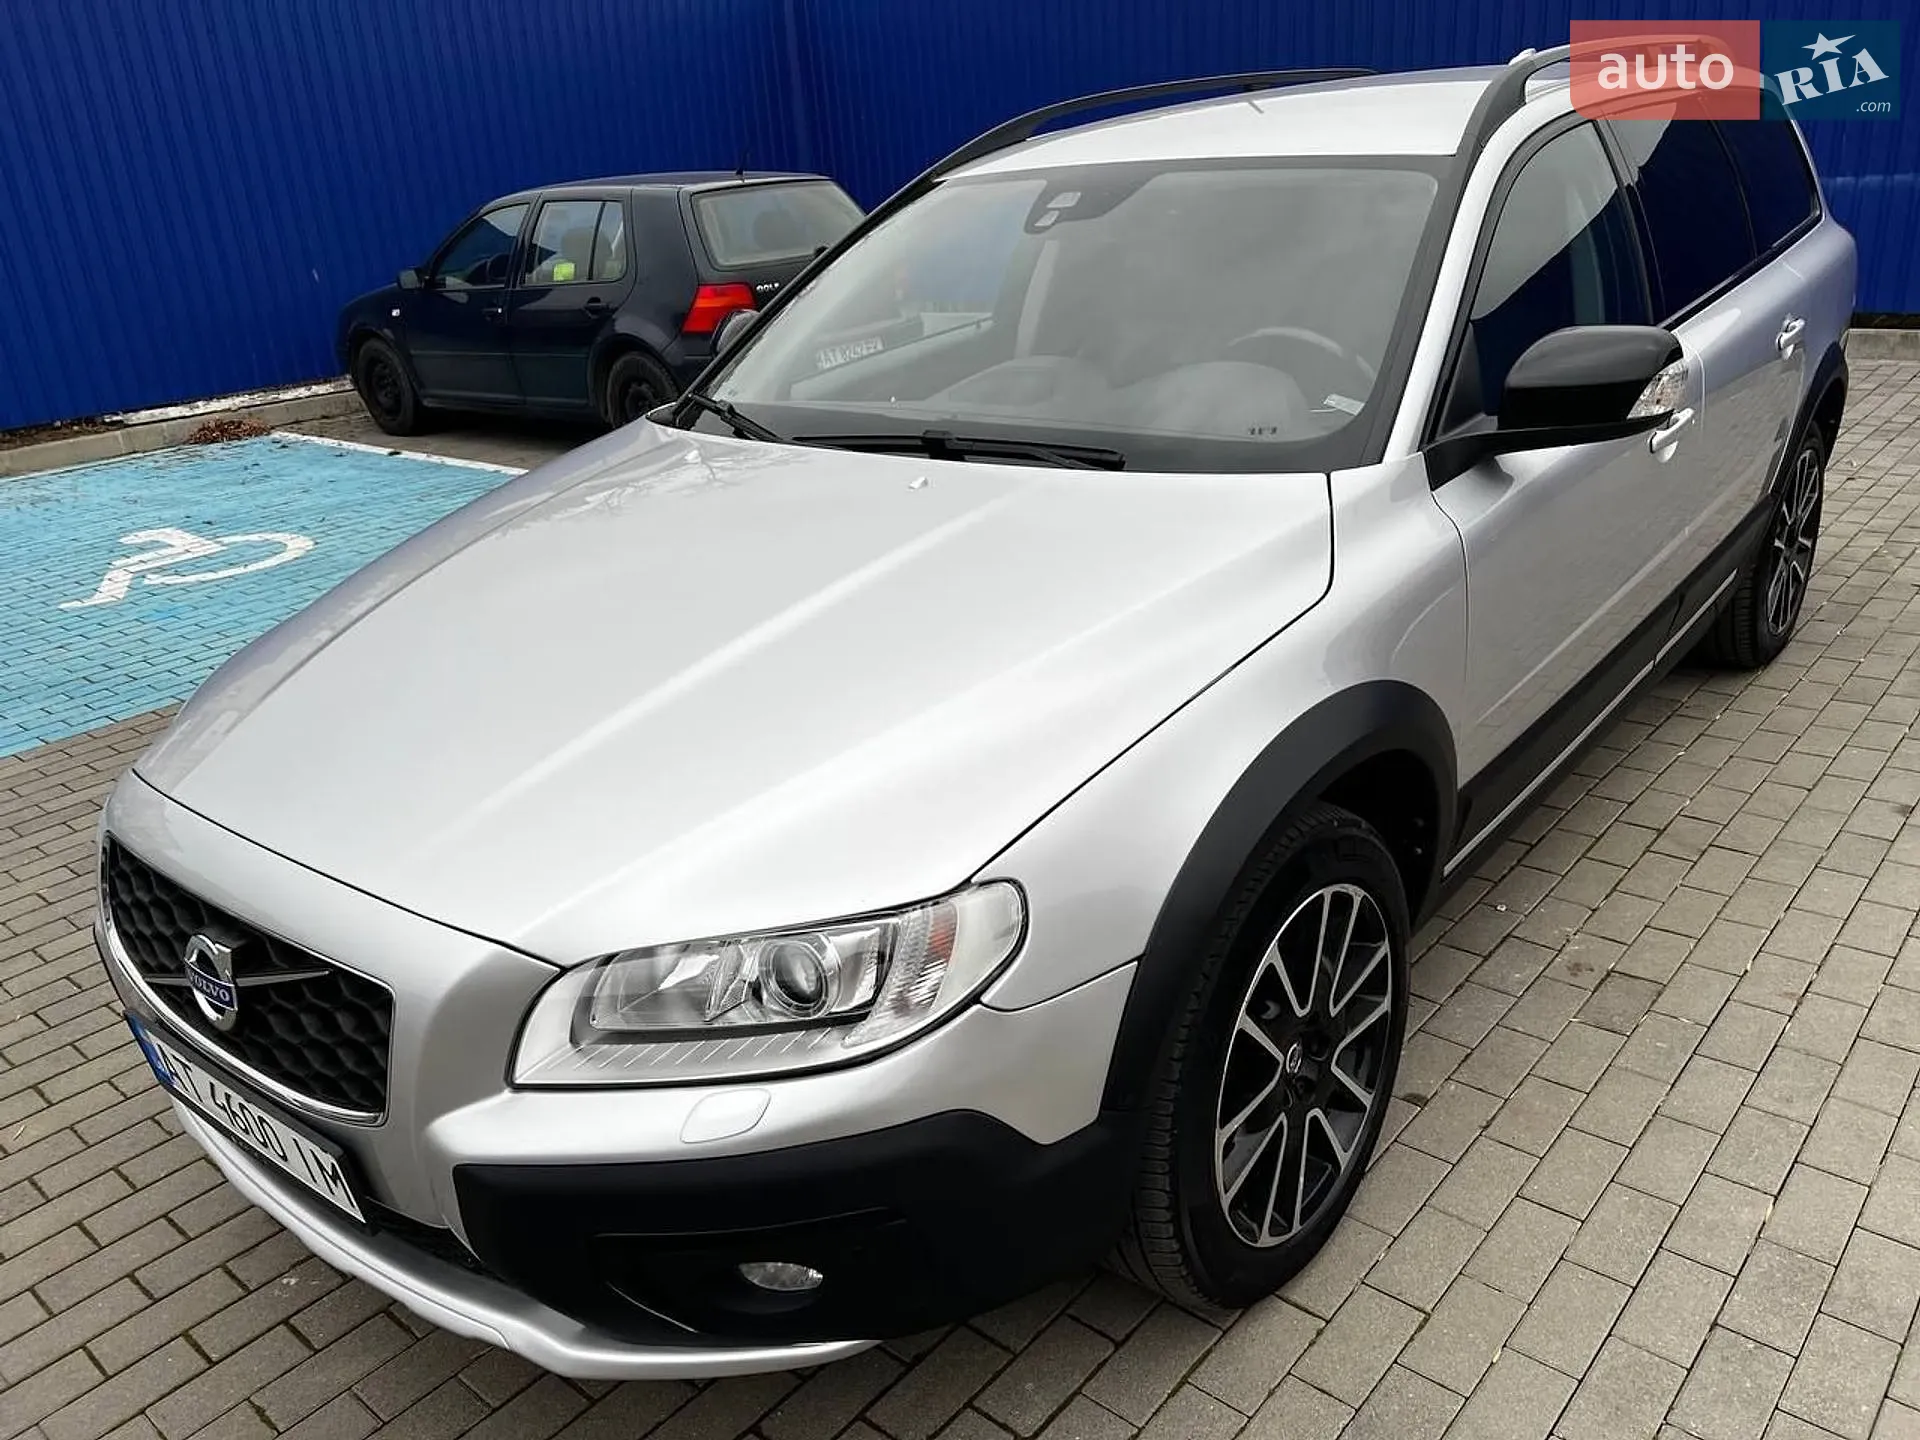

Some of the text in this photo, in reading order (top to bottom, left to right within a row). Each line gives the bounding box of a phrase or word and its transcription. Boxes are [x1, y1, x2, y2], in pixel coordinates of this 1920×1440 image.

[157, 1043, 357, 1208] AT 4600 IM
